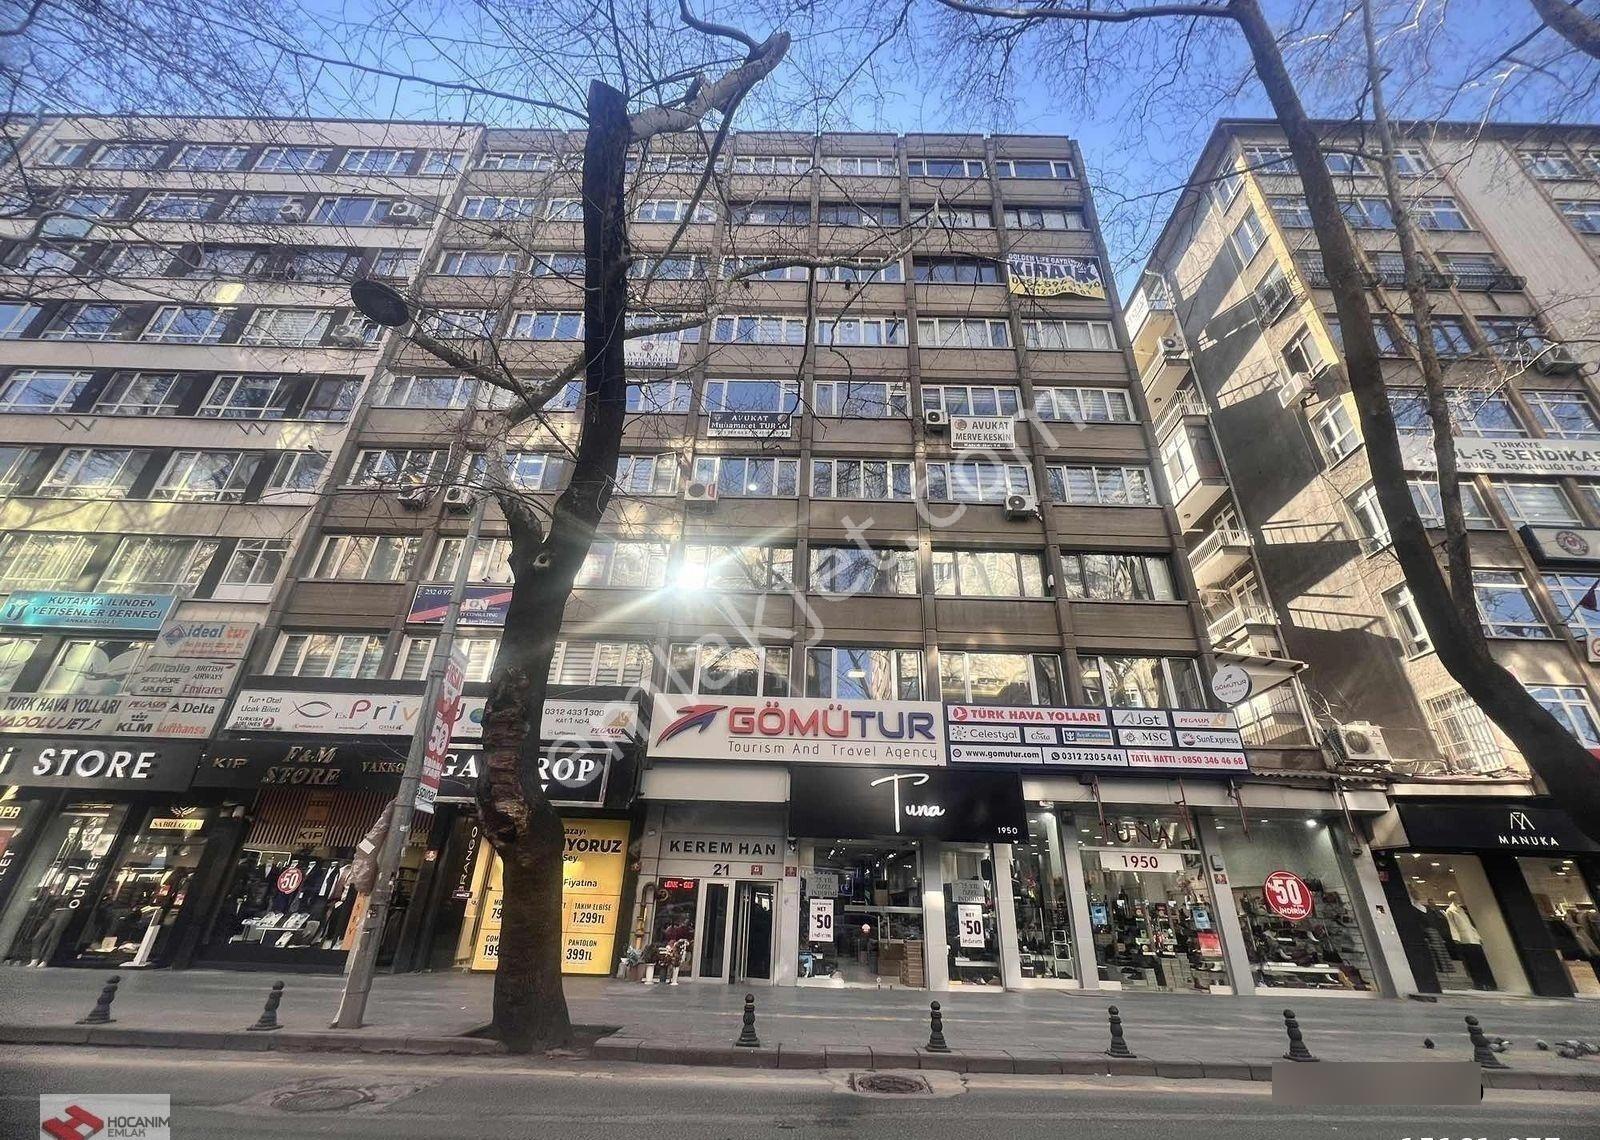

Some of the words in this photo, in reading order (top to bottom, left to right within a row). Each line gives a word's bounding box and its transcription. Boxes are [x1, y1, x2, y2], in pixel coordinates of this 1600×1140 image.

[972, 421, 1009, 430] AVUKAT
[955, 432, 982, 441] MERVE
[186, 624, 226, 639] ideal
[182, 684, 225, 695] Emirates
[36, 698, 69, 714] HAVA
[70, 698, 122, 715] YOLLARI
[182, 702, 215, 715] Delta
[544, 708, 566, 716] 0312
[970, 707, 1005, 720] TÜRK
[1009, 710, 1045, 721] HAVA
[729, 701, 937, 740] GÖMÜTUR
[115, 722, 153, 733] KLM
[969, 728, 1018, 742] Celestyal
[1140, 732, 1168, 742] MSC
[1195, 734, 1239, 745] SunExpress
[727, 740, 785, 755] Tourism
[792, 743, 820, 756] And
[831, 743, 877, 758] Travel
[885, 746, 938, 761] Agency
[965, 749, 1040, 759] www.gomutur.com
[1061, 752, 1081, 761] 0312
[1083, 753, 1100, 762] 230
[1100, 753, 1122, 762] 5441
[1153, 755, 1176, 764] HATTI
[1204, 756, 1220, 765] 346
[33, 748, 156, 779] STORE
[261, 766, 343, 786] STORE
[870, 773, 946, 834] Tuna
[997, 827, 1018, 835] 1950
[1498, 835, 1560, 846] MANUKA
[669, 840, 733, 854] KEREM
[738, 842, 776, 855] HAN
[1121, 855, 1159, 869] 1950
[712, 863, 730, 876] 21
[69, 853, 104, 909] OUTLET
[568, 938, 597, 947] PANTOLON
